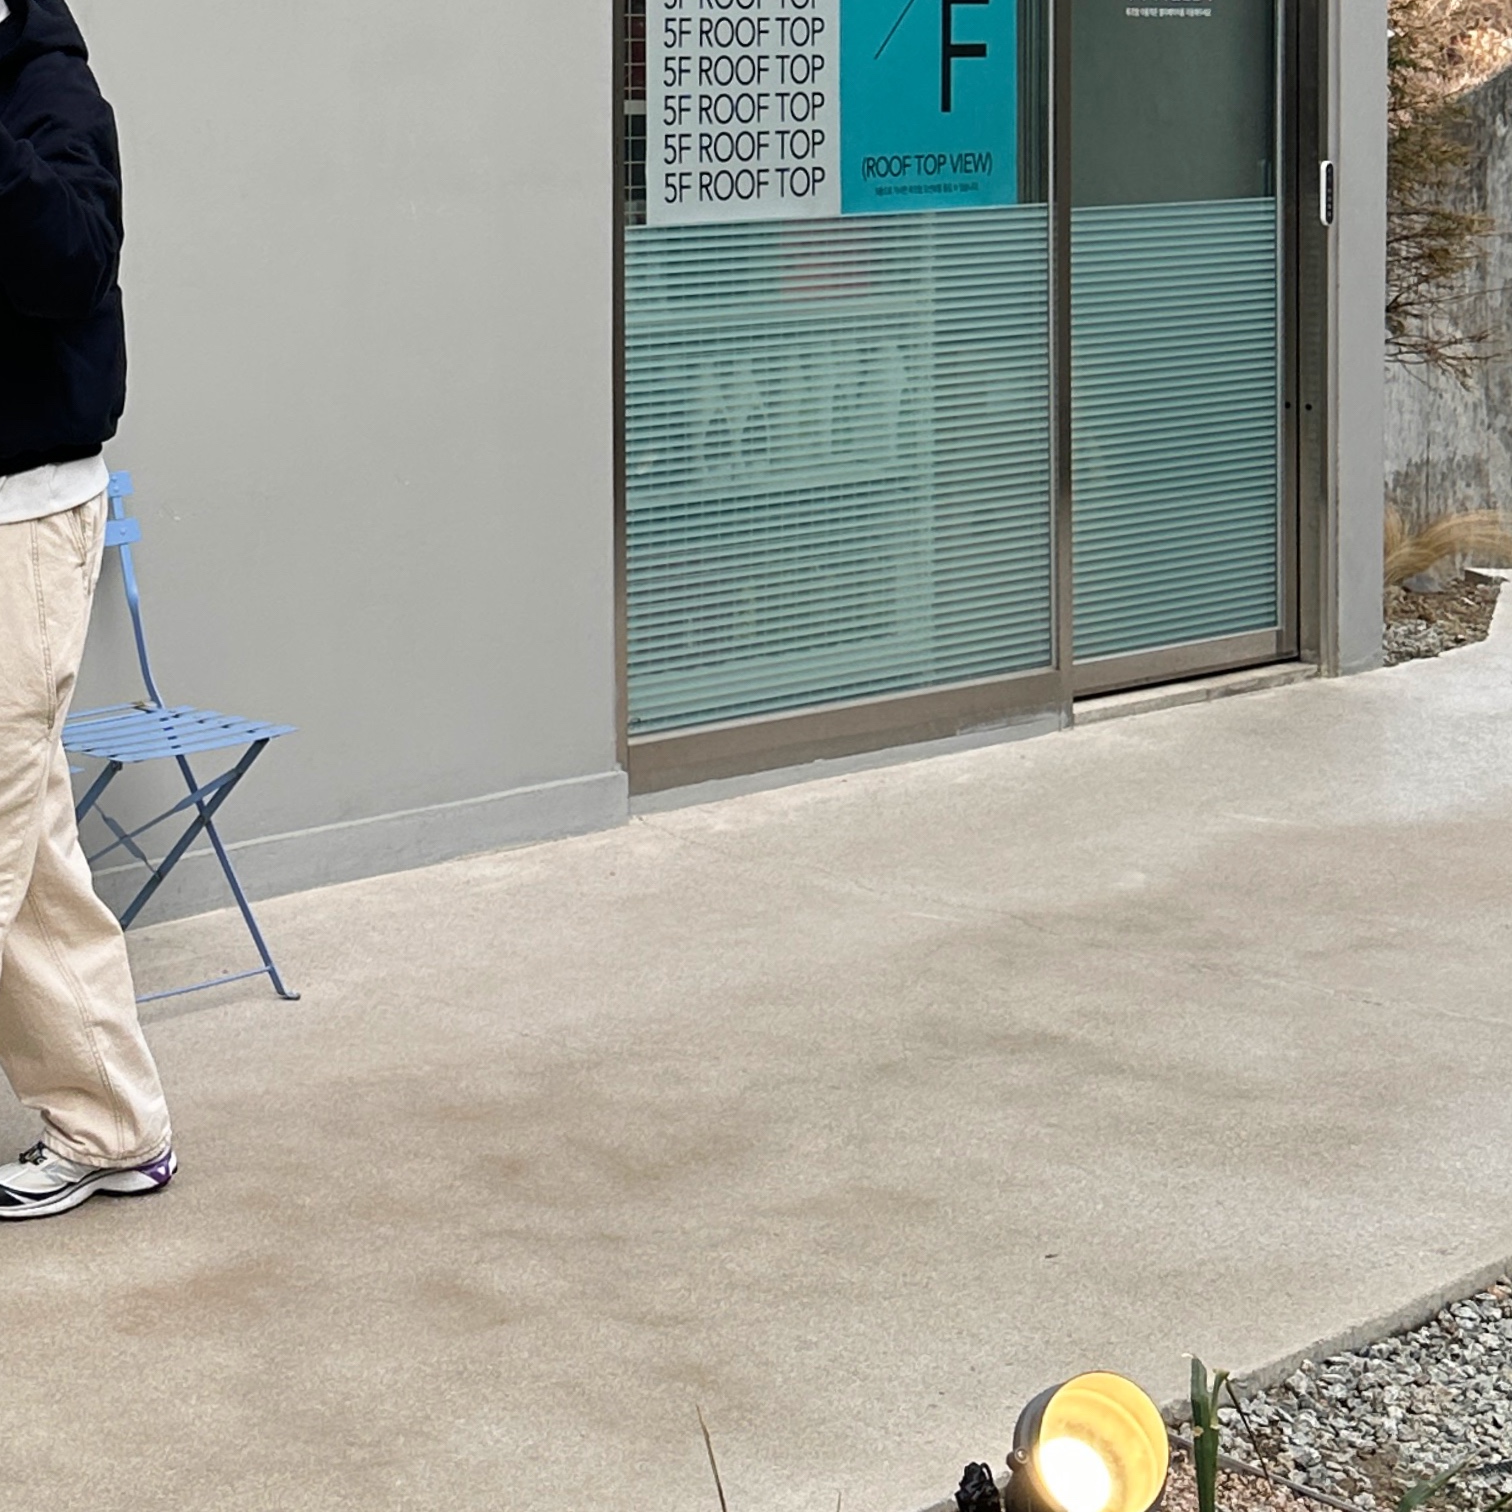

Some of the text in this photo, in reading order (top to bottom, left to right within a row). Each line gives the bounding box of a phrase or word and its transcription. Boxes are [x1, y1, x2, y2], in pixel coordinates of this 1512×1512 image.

[663, 17, 692, 49] 5F
[663, 55, 692, 88] 5F
[663, 94, 692, 126] 5F
[663, 133, 692, 165] 5F
[949, 152, 993, 176] VIEW)
[664, 171, 693, 204] 5F
